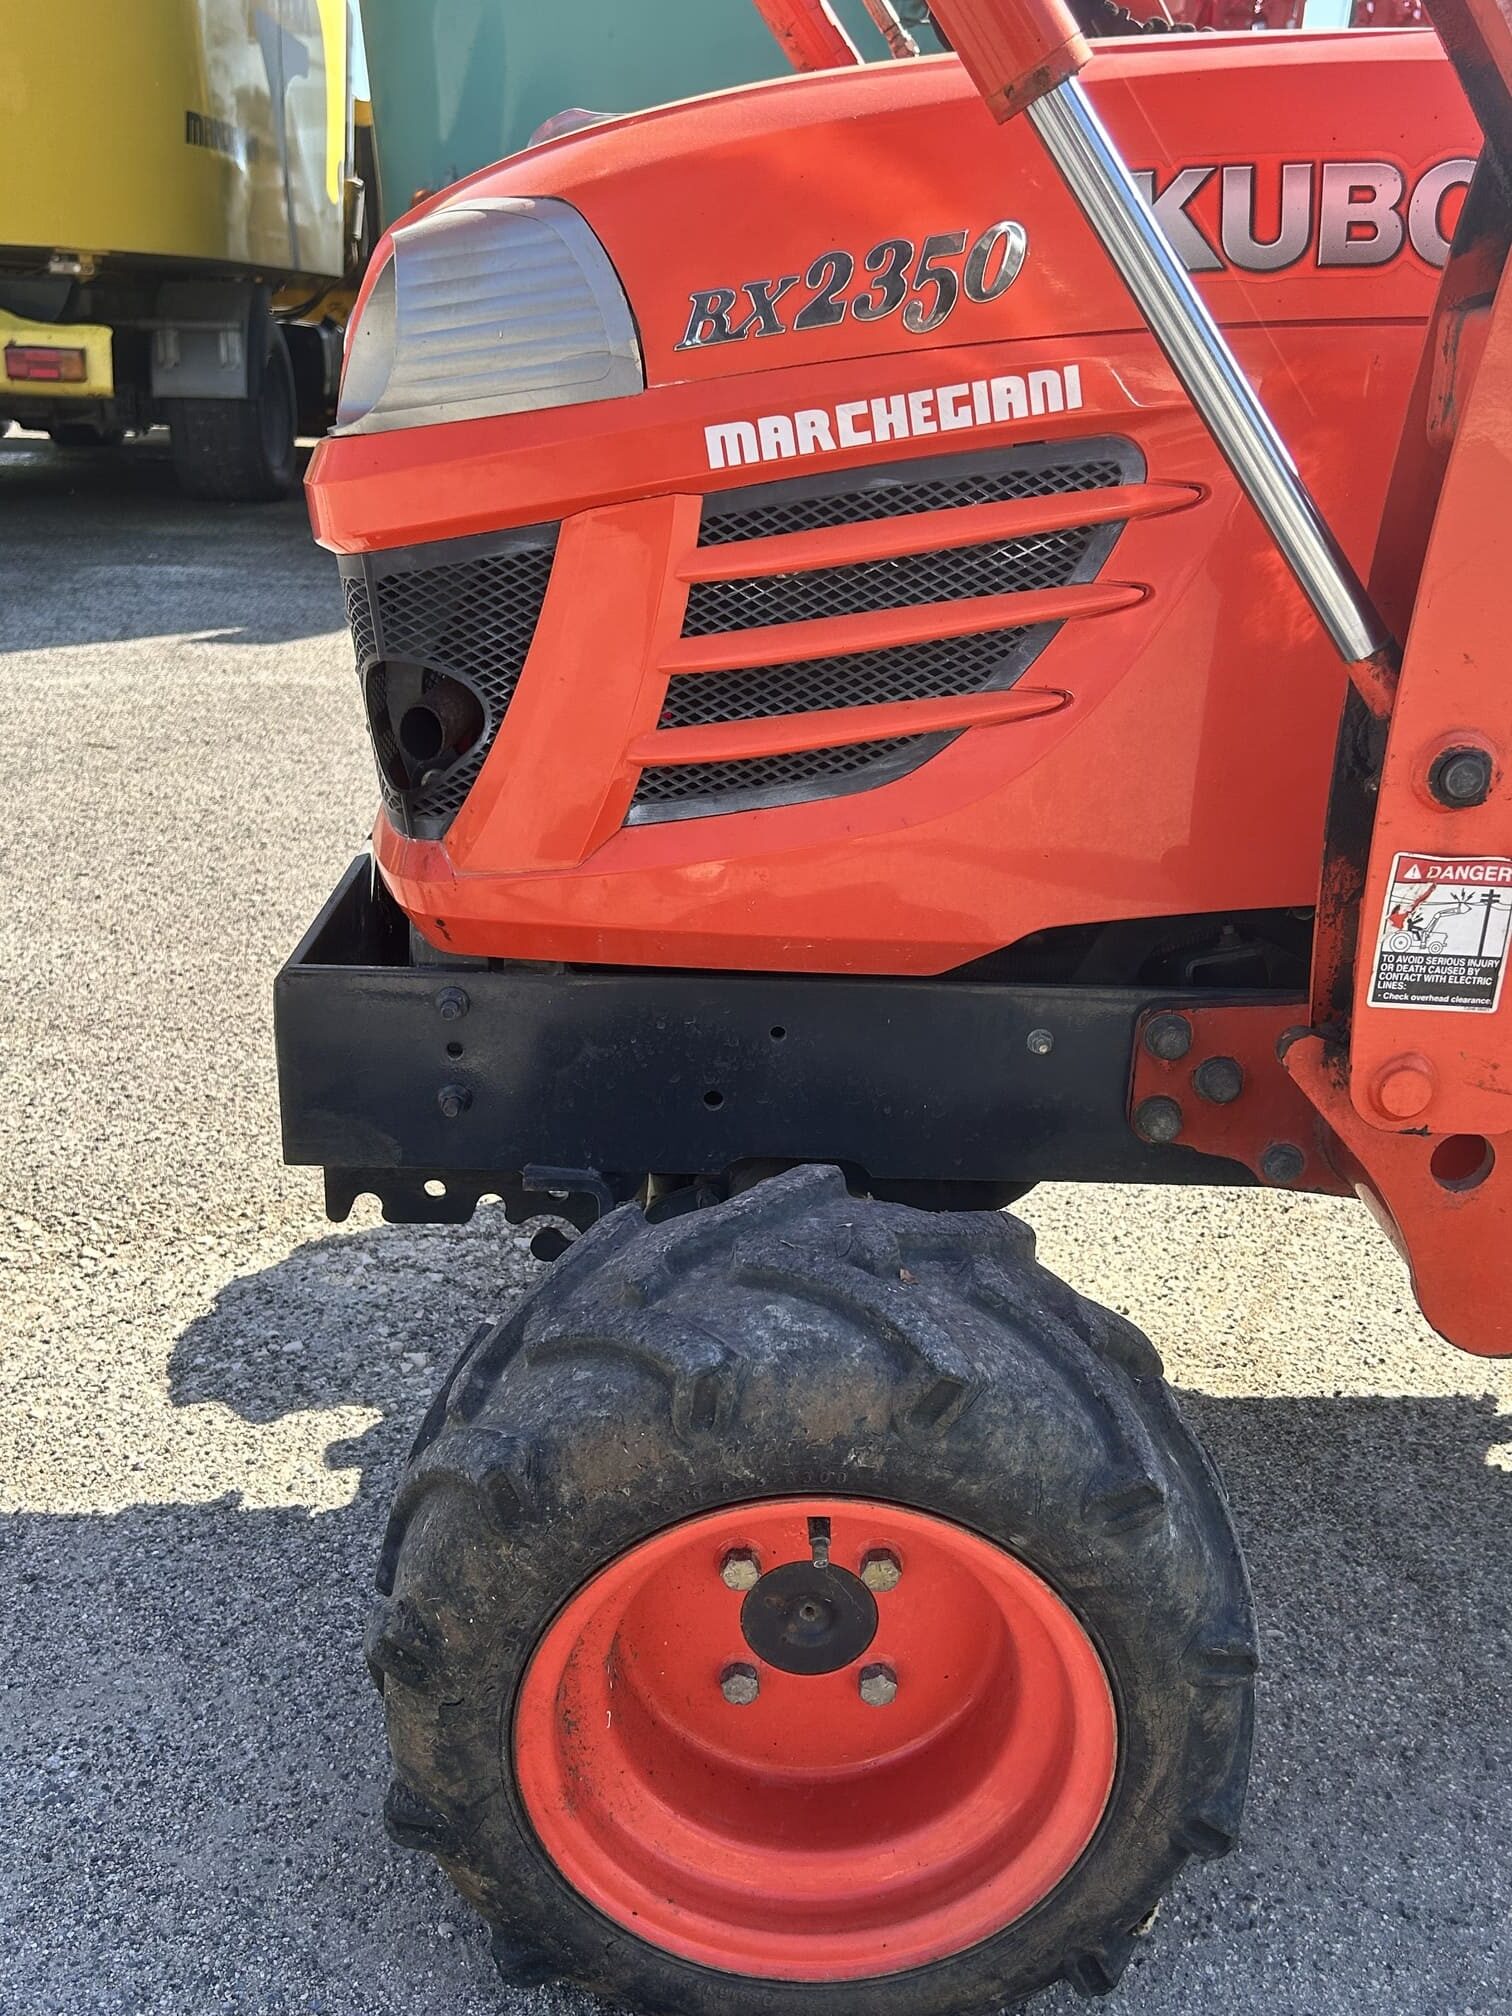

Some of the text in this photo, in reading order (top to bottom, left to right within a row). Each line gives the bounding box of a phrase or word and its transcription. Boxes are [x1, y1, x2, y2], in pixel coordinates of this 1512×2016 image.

[704, 364, 1083, 470] MARCHEGIANI
[1426, 865, 1512, 882] DANGER
[1382, 954, 1500, 968] TO AVOID SERIOUS INJURY
[1380, 963, 1480, 976] OR DEATH CAUSED BY
[1377, 980, 1407, 990] LINES:
[1379, 972, 1493, 986] CONTACT WITH ELECTRIC
[1383, 992, 1409, 1000] Check
[1410, 994, 1450, 1003] overhead
